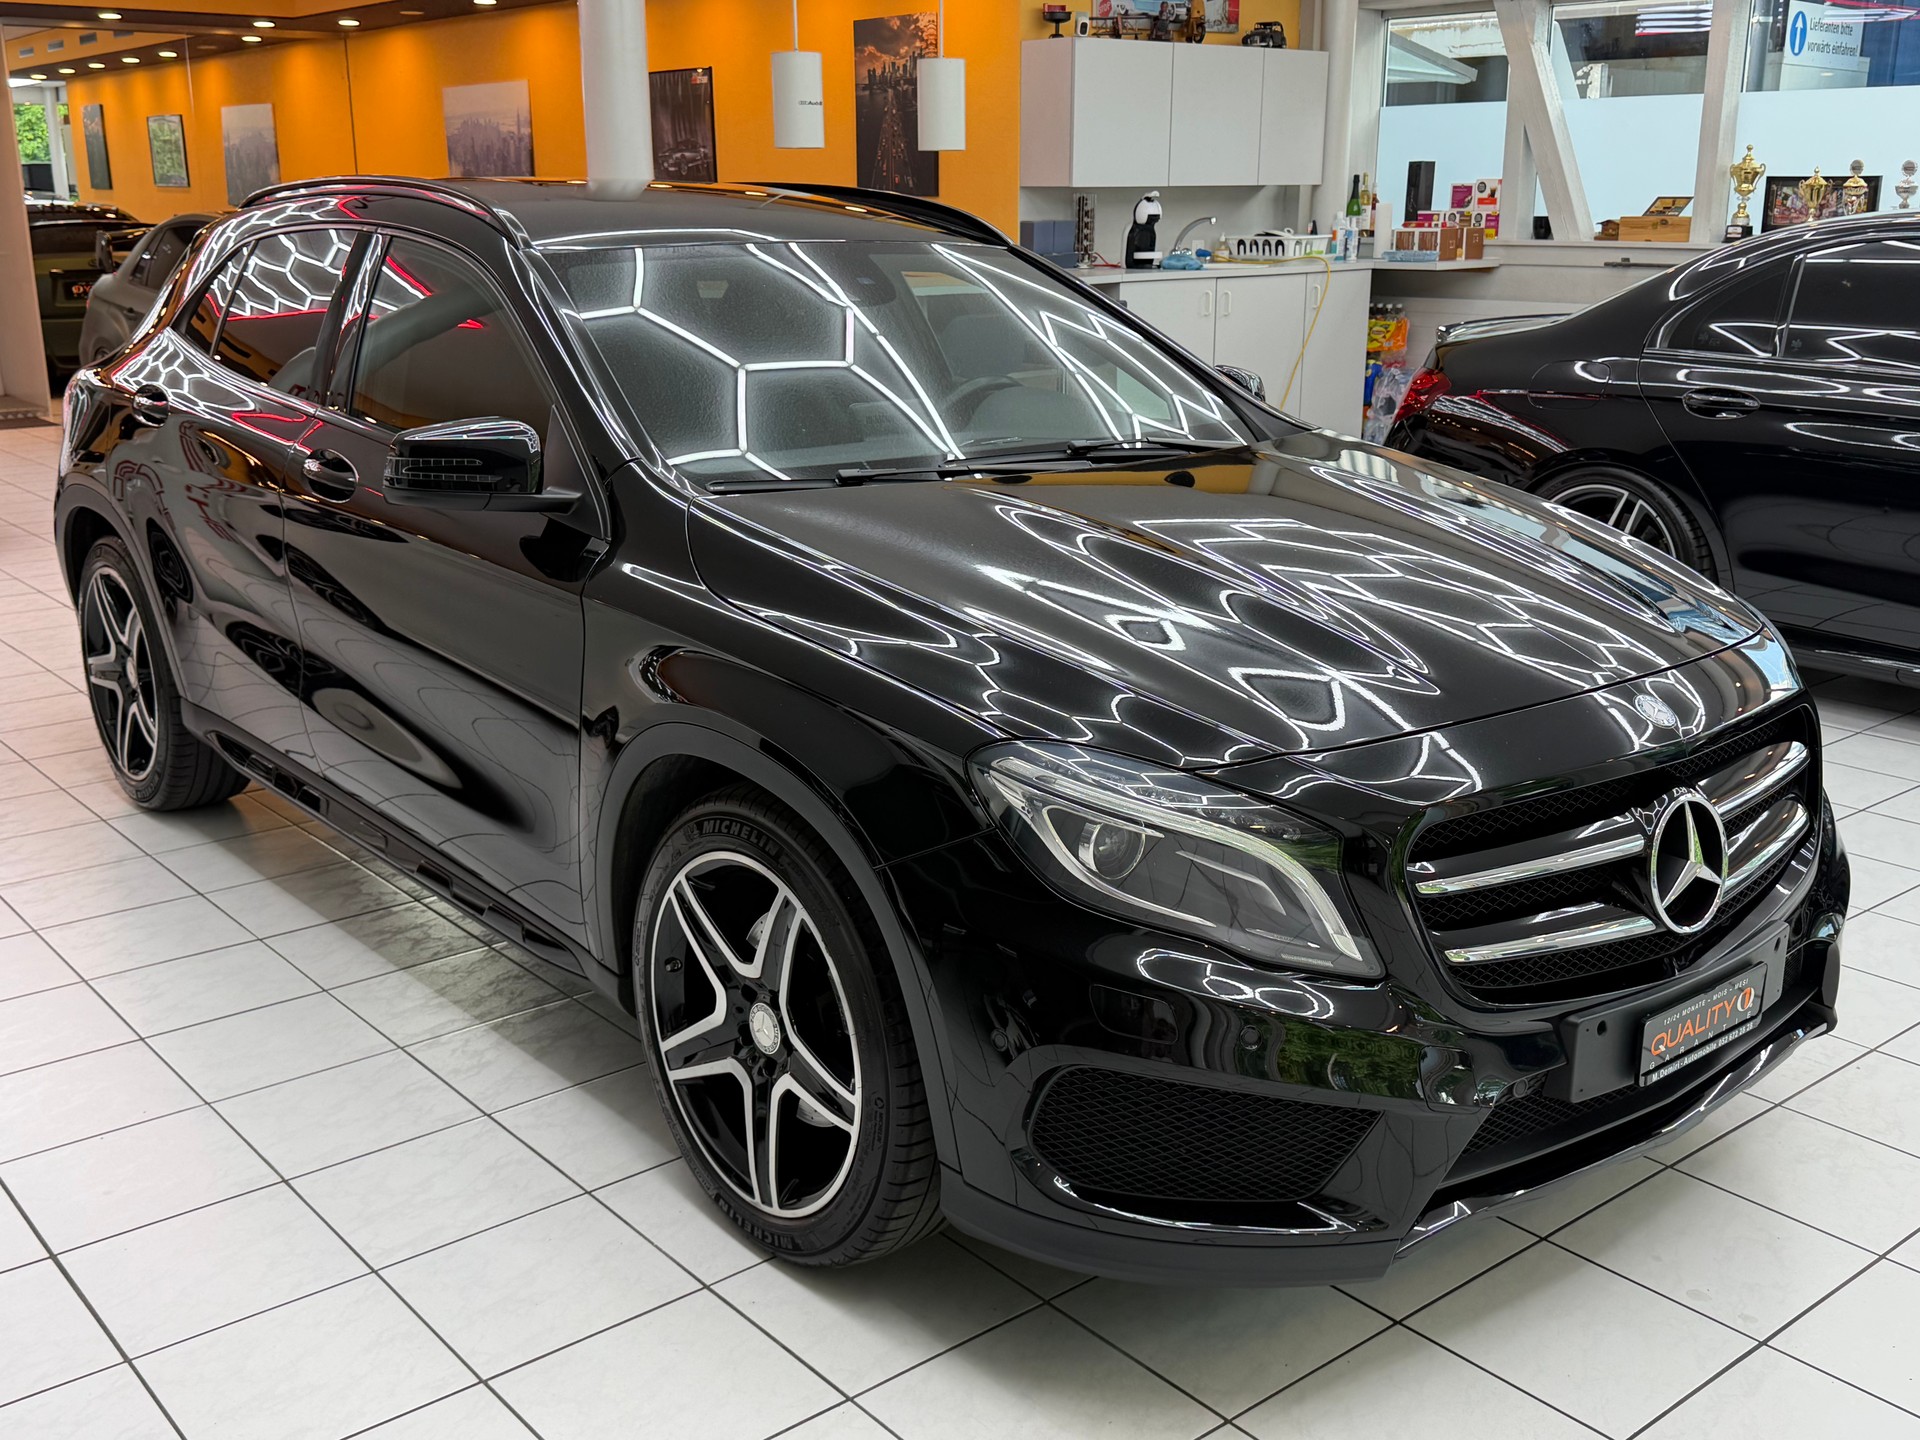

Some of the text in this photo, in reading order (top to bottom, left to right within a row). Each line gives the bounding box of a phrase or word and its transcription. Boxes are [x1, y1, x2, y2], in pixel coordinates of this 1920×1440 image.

[1810, 17, 1853, 36] Lieferanten bitte
[1807, 40, 1859, 57] vorwärts einfahren!
[702, 819, 780, 857] MICHELIN
[1663, 1012, 1680, 1025] 12/24
[1682, 999, 1706, 1016] MONATE
[1713, 989, 1728, 1001] MOIS
[1734, 978, 1749, 989] MESI
[1649, 1011, 1752, 1070] GARANTIE
[718, 1200, 793, 1250] MICHELIN
